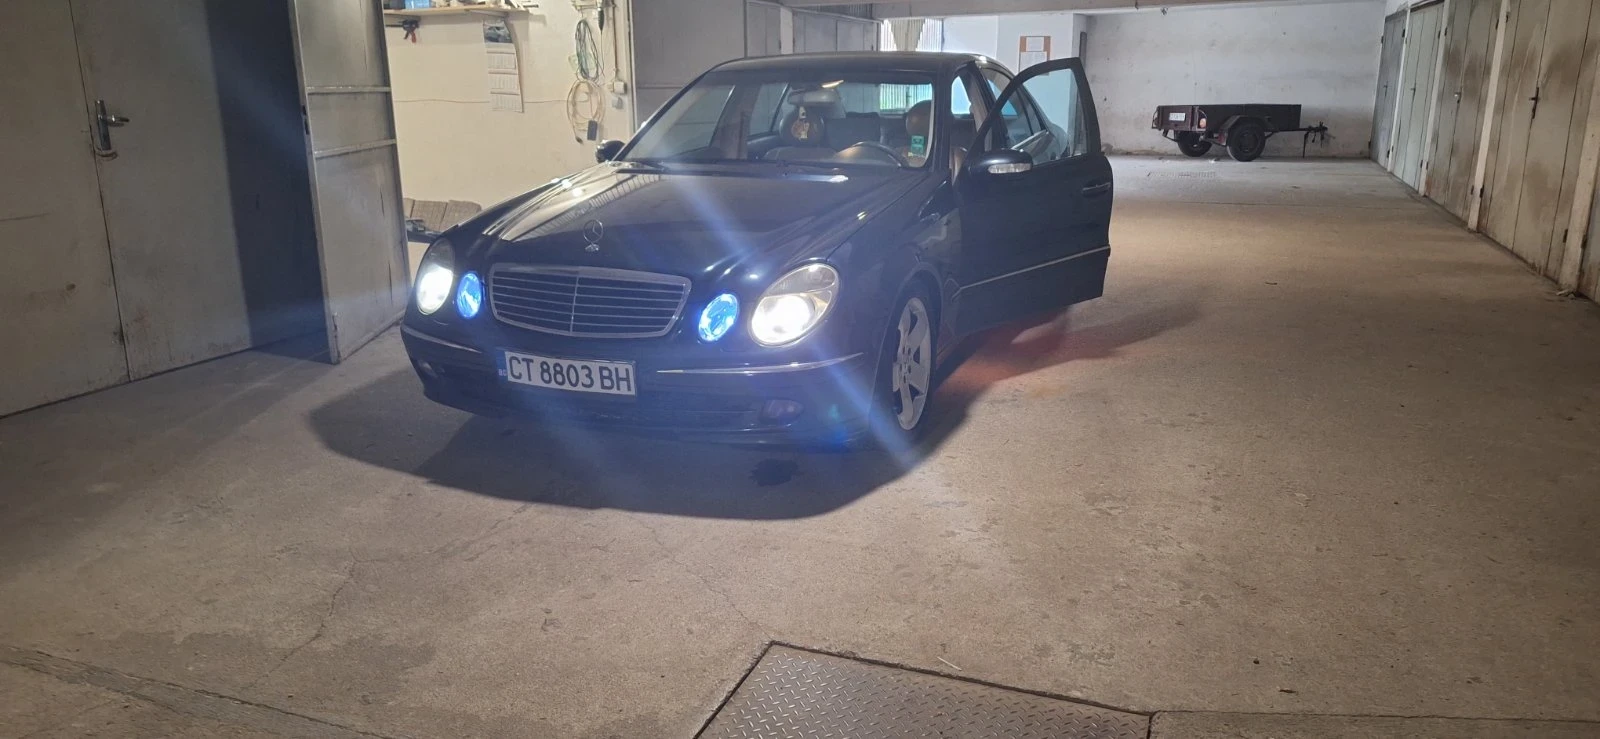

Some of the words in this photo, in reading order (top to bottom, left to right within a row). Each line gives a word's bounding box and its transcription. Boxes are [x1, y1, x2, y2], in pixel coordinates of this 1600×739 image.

[509, 356, 534, 381] CT
[540, 361, 594, 388] 8803
[599, 366, 632, 392] BH
